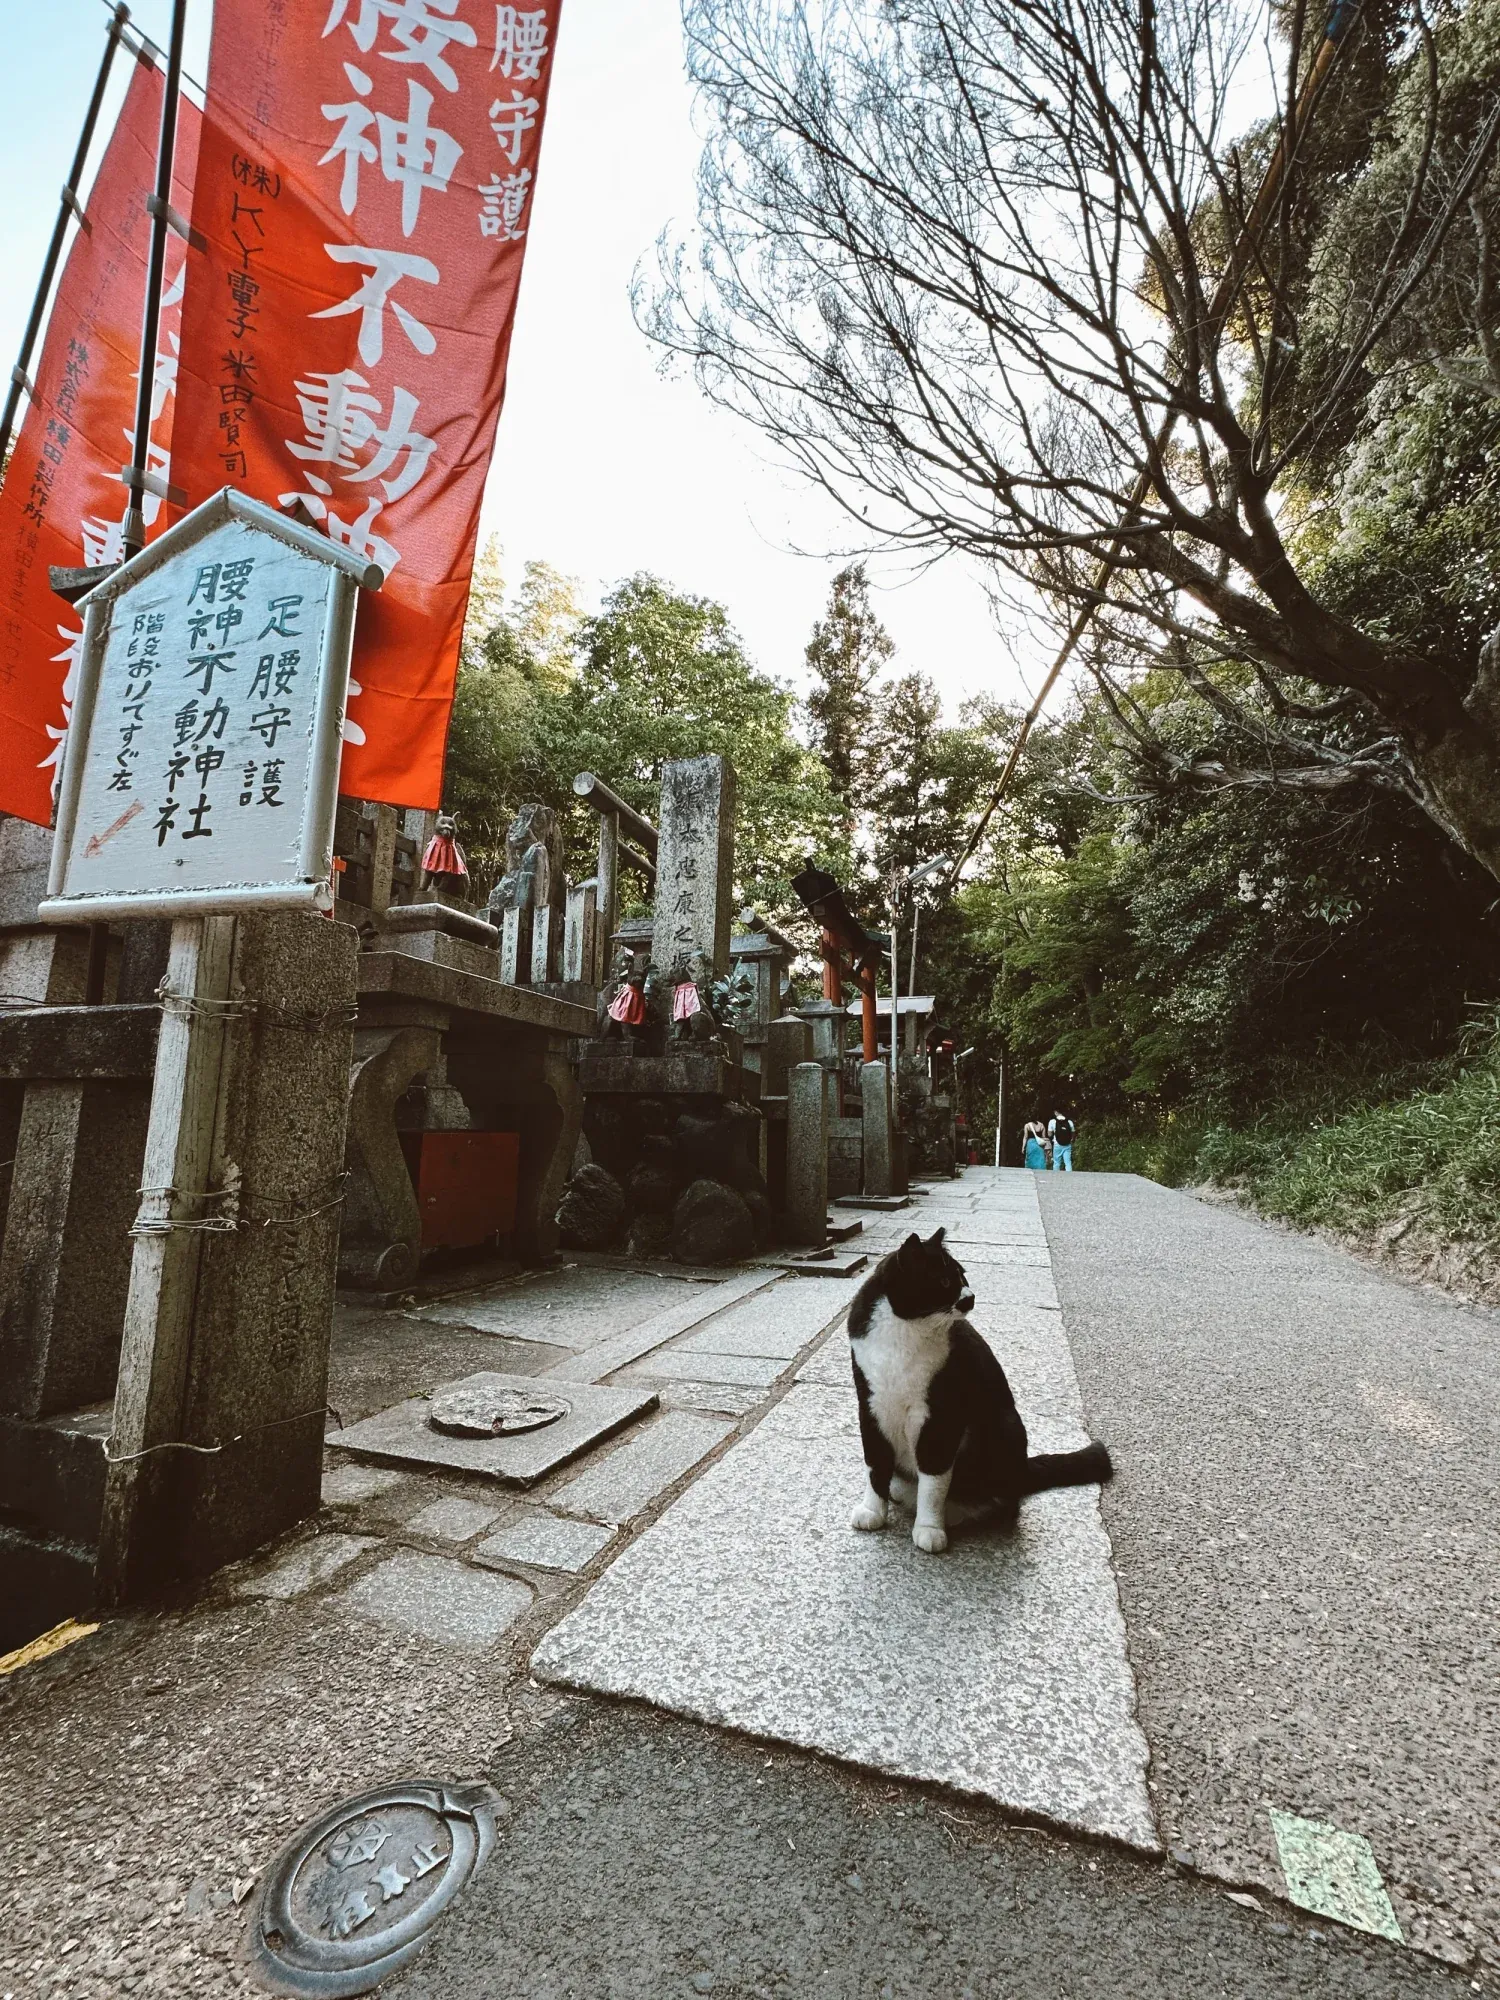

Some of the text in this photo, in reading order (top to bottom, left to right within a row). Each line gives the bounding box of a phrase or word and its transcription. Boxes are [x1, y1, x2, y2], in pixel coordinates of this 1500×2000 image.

[478, 4, 548, 242] 腰守護
[219, 349, 258, 478] 米田賢司
[106, 613, 165, 790] 階段おりてすぐ左
[152, 557, 255, 847] 腰神不動神社
[239, 595, 303, 806] 足腰守護
